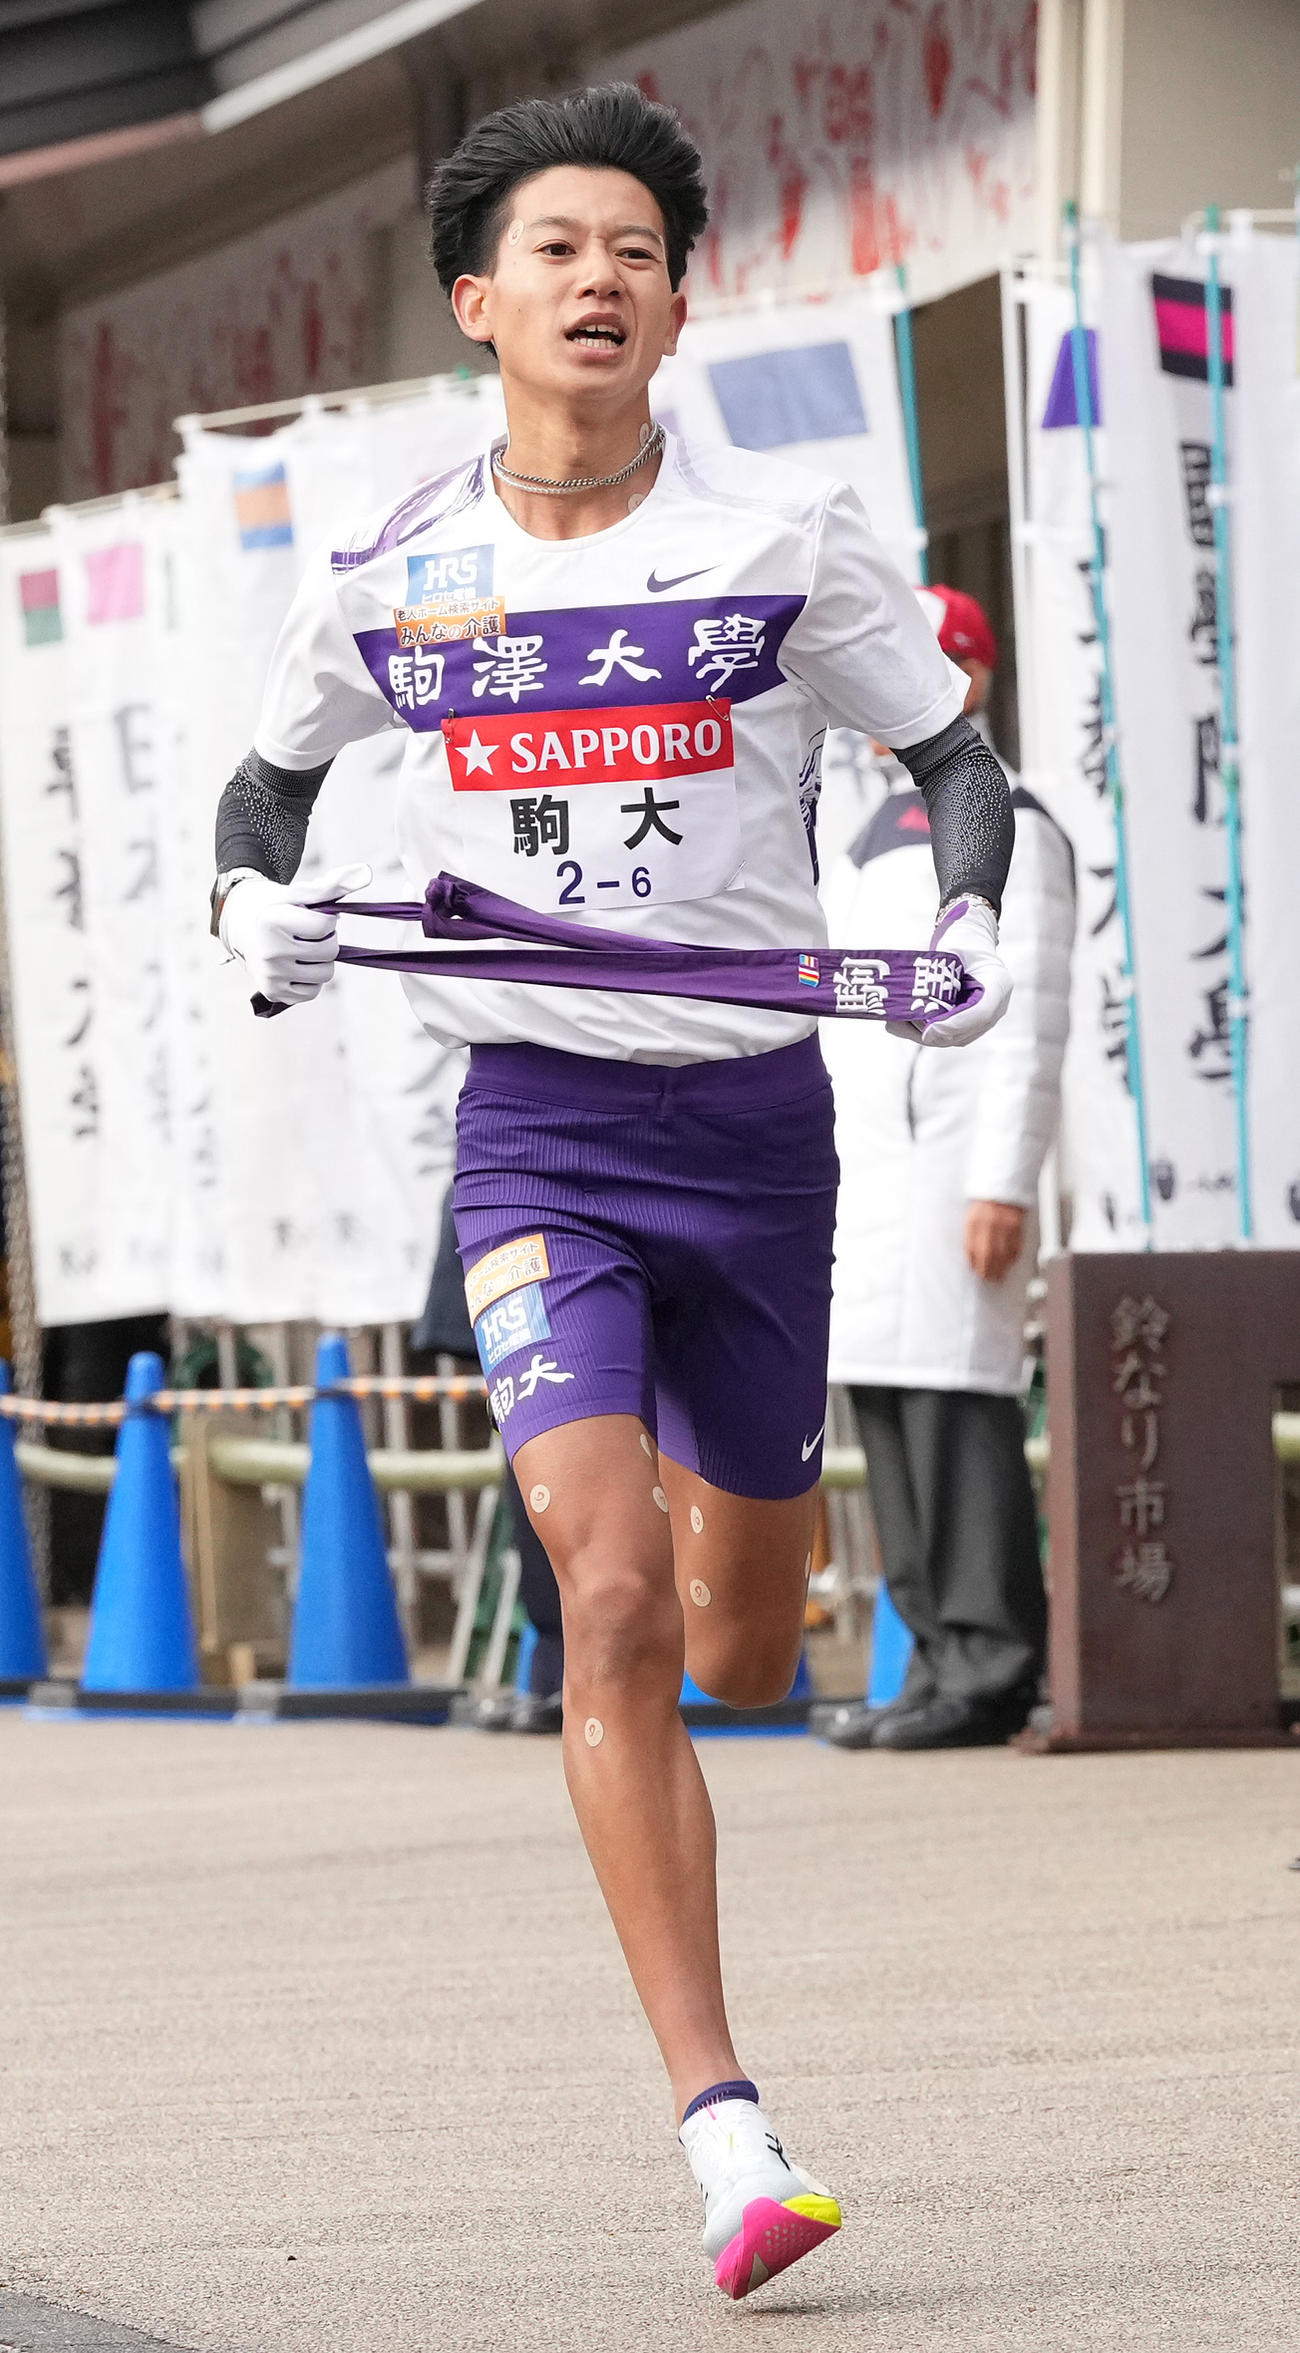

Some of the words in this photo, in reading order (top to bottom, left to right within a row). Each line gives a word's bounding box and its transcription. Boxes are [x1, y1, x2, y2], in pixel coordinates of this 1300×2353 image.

[423, 551, 479, 591] HRS
[396, 599, 500, 622] 老人ホーム検索サイト
[400, 615, 501, 645] みんなの介護
[511, 719, 723, 774] SAPPORO
[509, 786, 684, 858] 駒大
[481, 1295, 528, 1351] HRS
[489, 1353, 576, 1424] 駒大
[1109, 1295, 1175, 1602] 鈴なり市場
